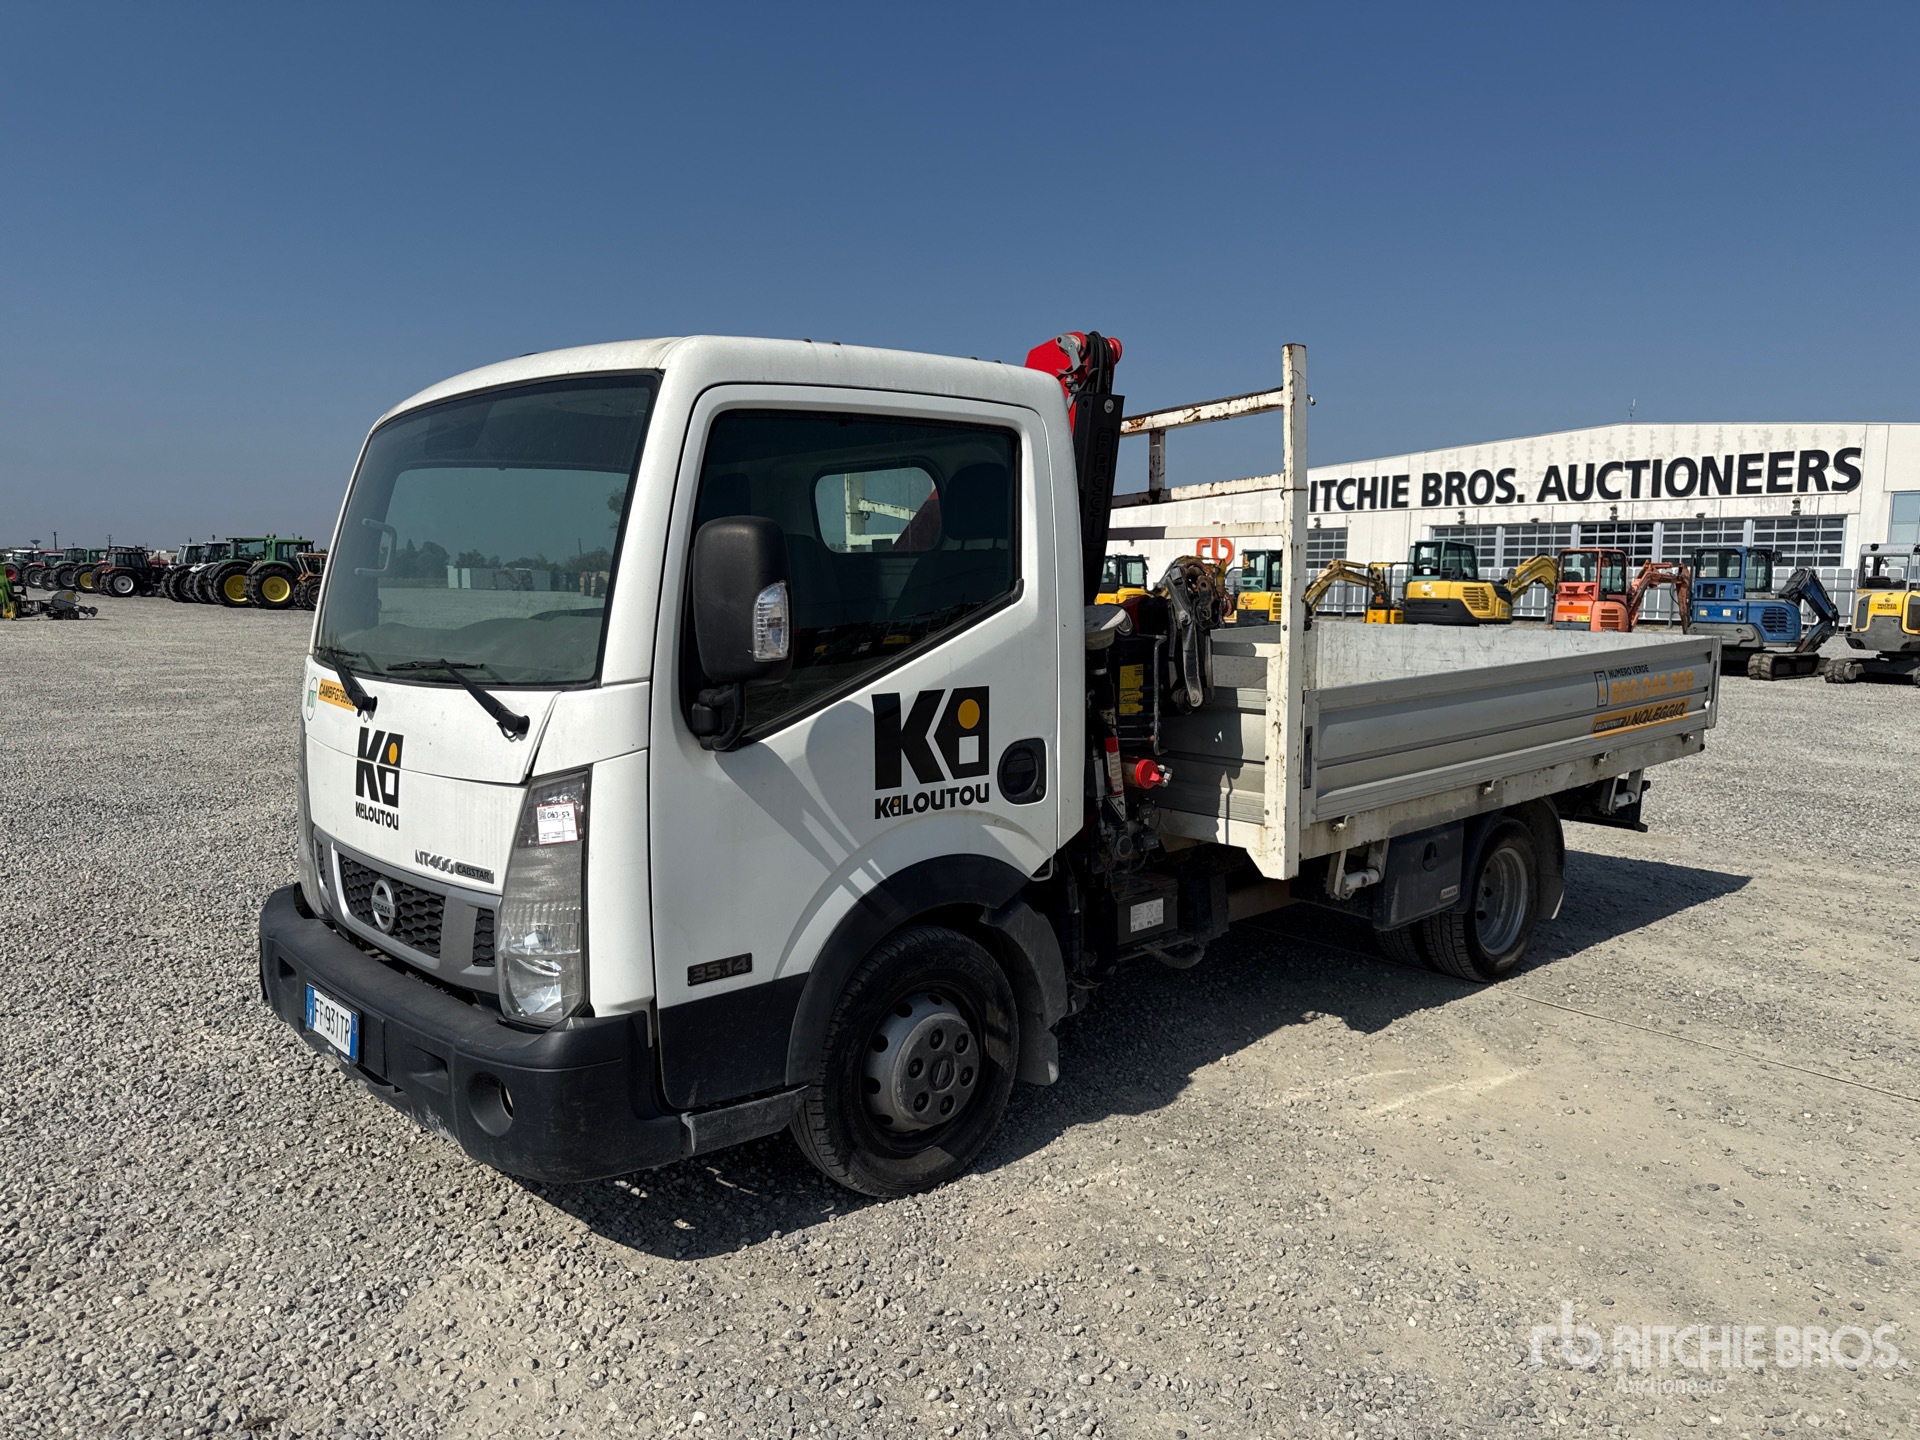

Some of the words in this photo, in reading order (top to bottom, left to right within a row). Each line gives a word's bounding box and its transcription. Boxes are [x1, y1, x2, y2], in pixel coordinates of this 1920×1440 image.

[1309, 474, 1410, 513] ITCHIE
[1421, 468, 1526, 507] BROS.
[1536, 447, 1863, 503] AUCTIONEERS
[1608, 667, 1632, 678] NUMERO
[1632, 664, 1649, 675] VERDE
[1630, 701, 1685, 726] NOLEGGIO
[457, 865, 490, 881] CABSTAR
